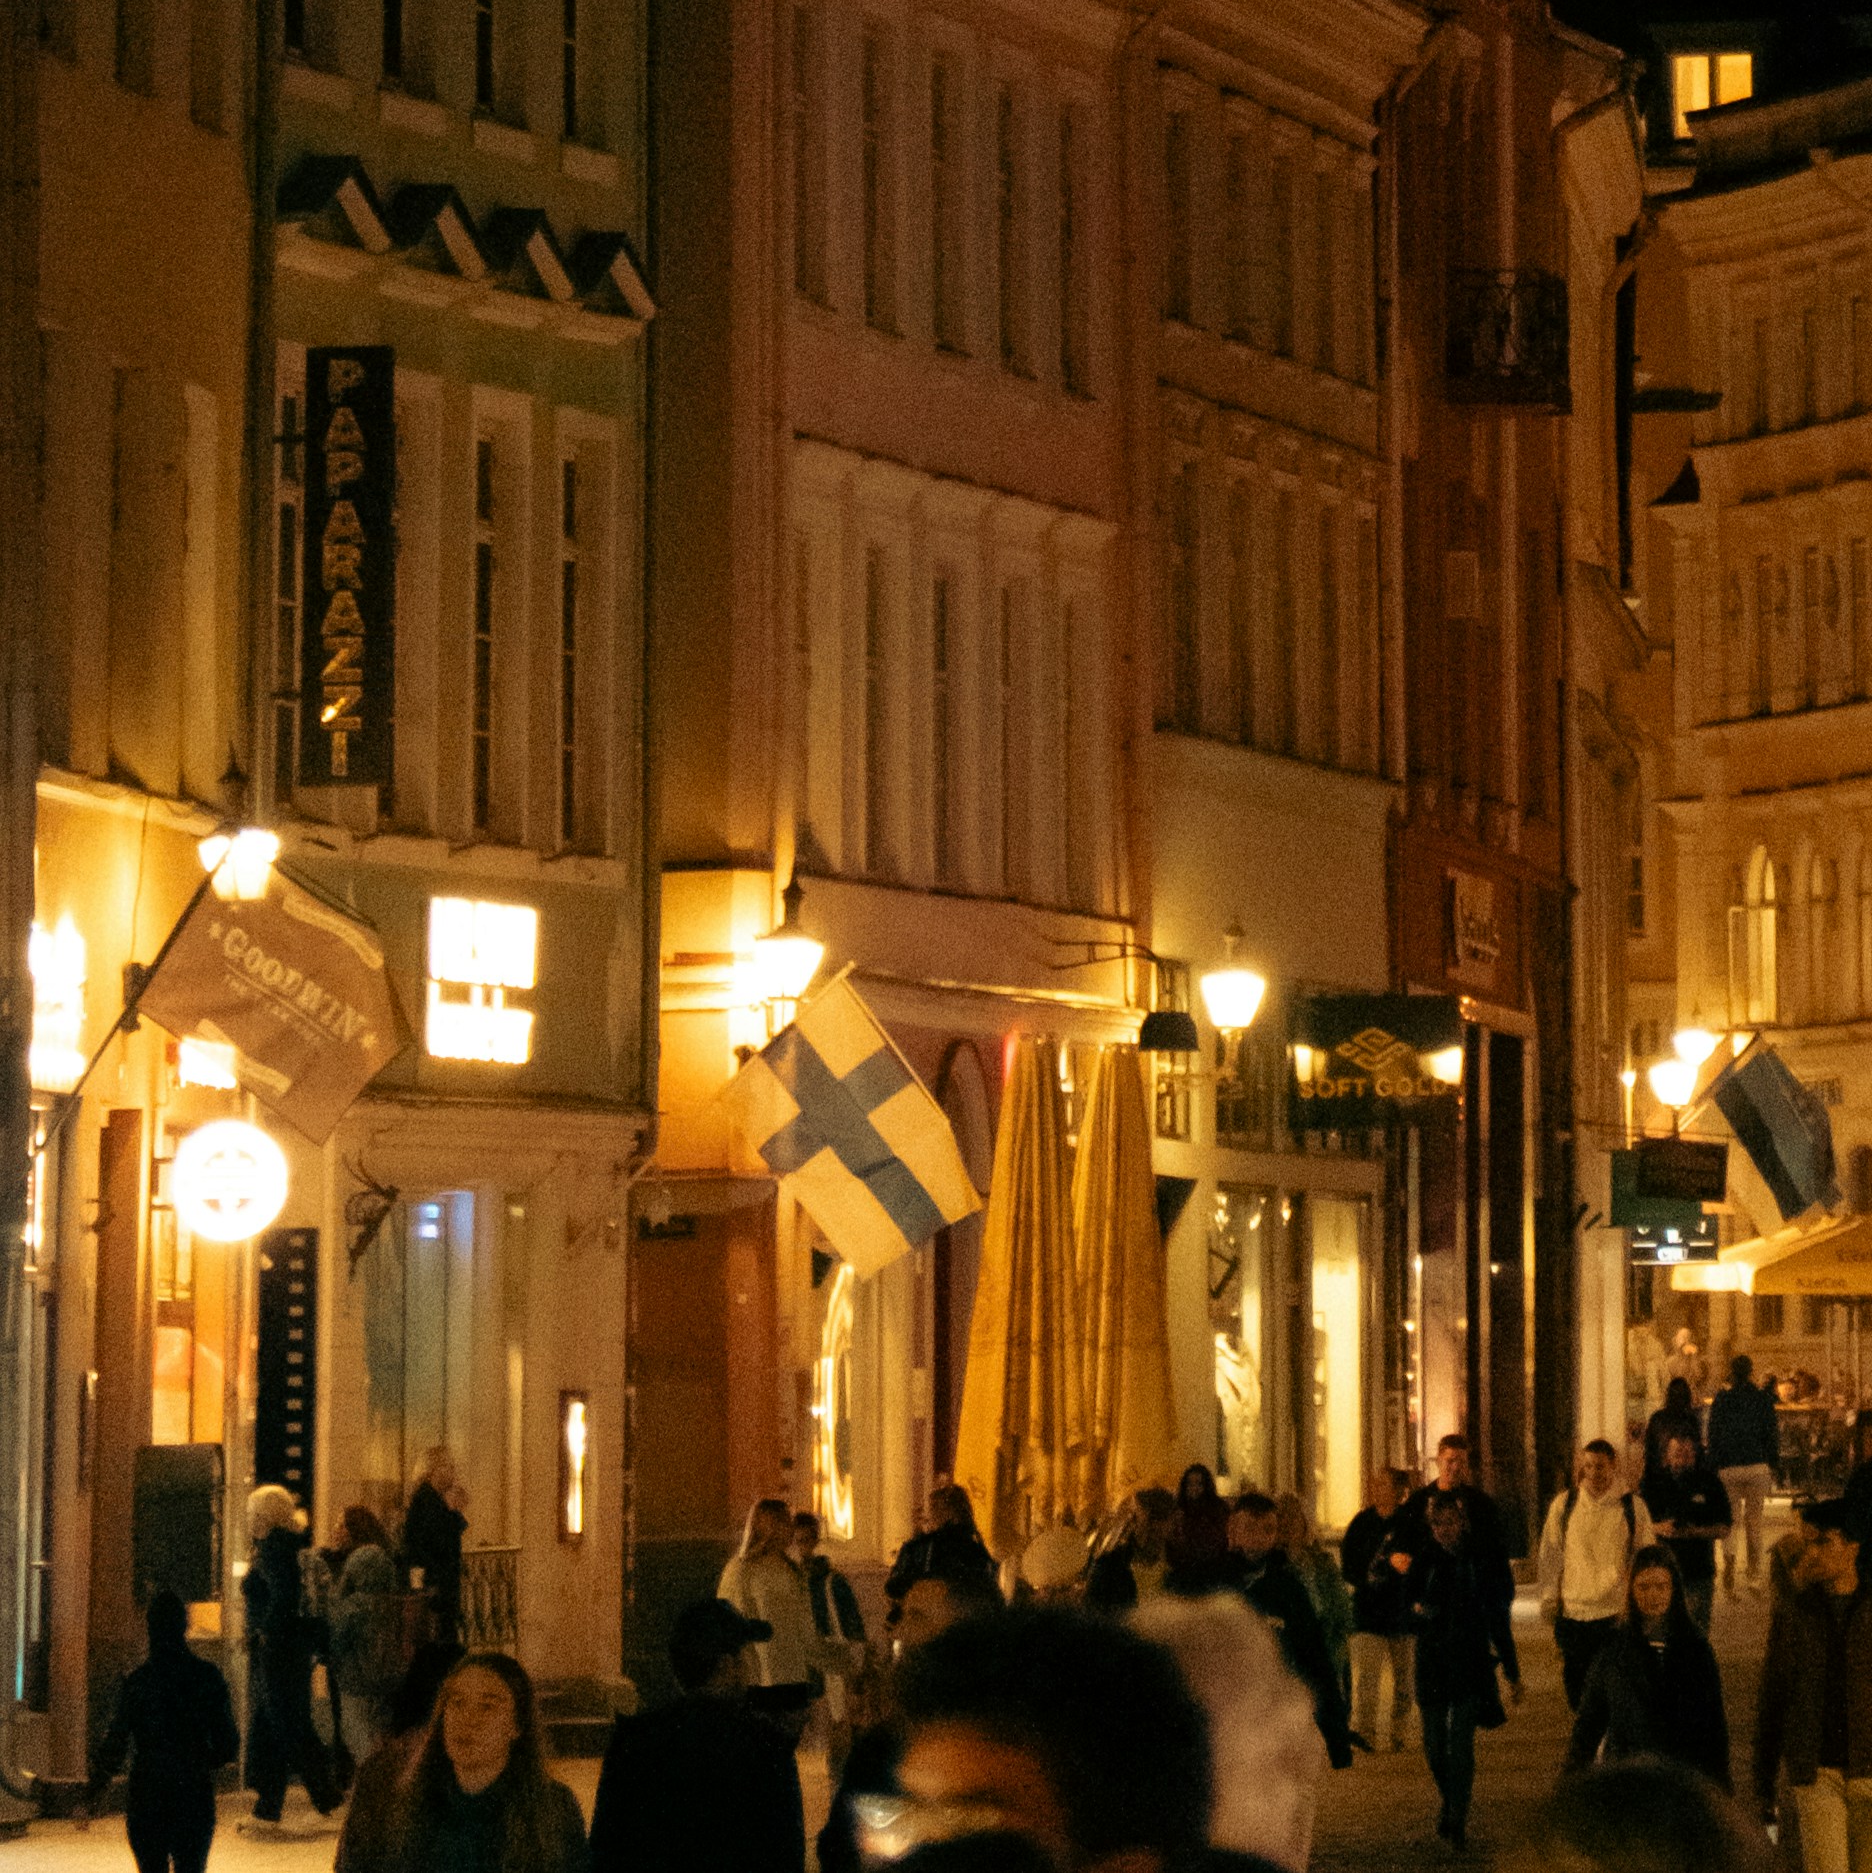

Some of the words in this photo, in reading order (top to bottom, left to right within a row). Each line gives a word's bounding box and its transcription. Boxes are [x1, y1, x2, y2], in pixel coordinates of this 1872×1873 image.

[320, 358, 367, 776] PAPARAZZI
[223, 926, 368, 1043] GOODWIN
[1300, 1077, 1367, 1099] SOFT
[1375, 1076, 1451, 1097] GOLD
